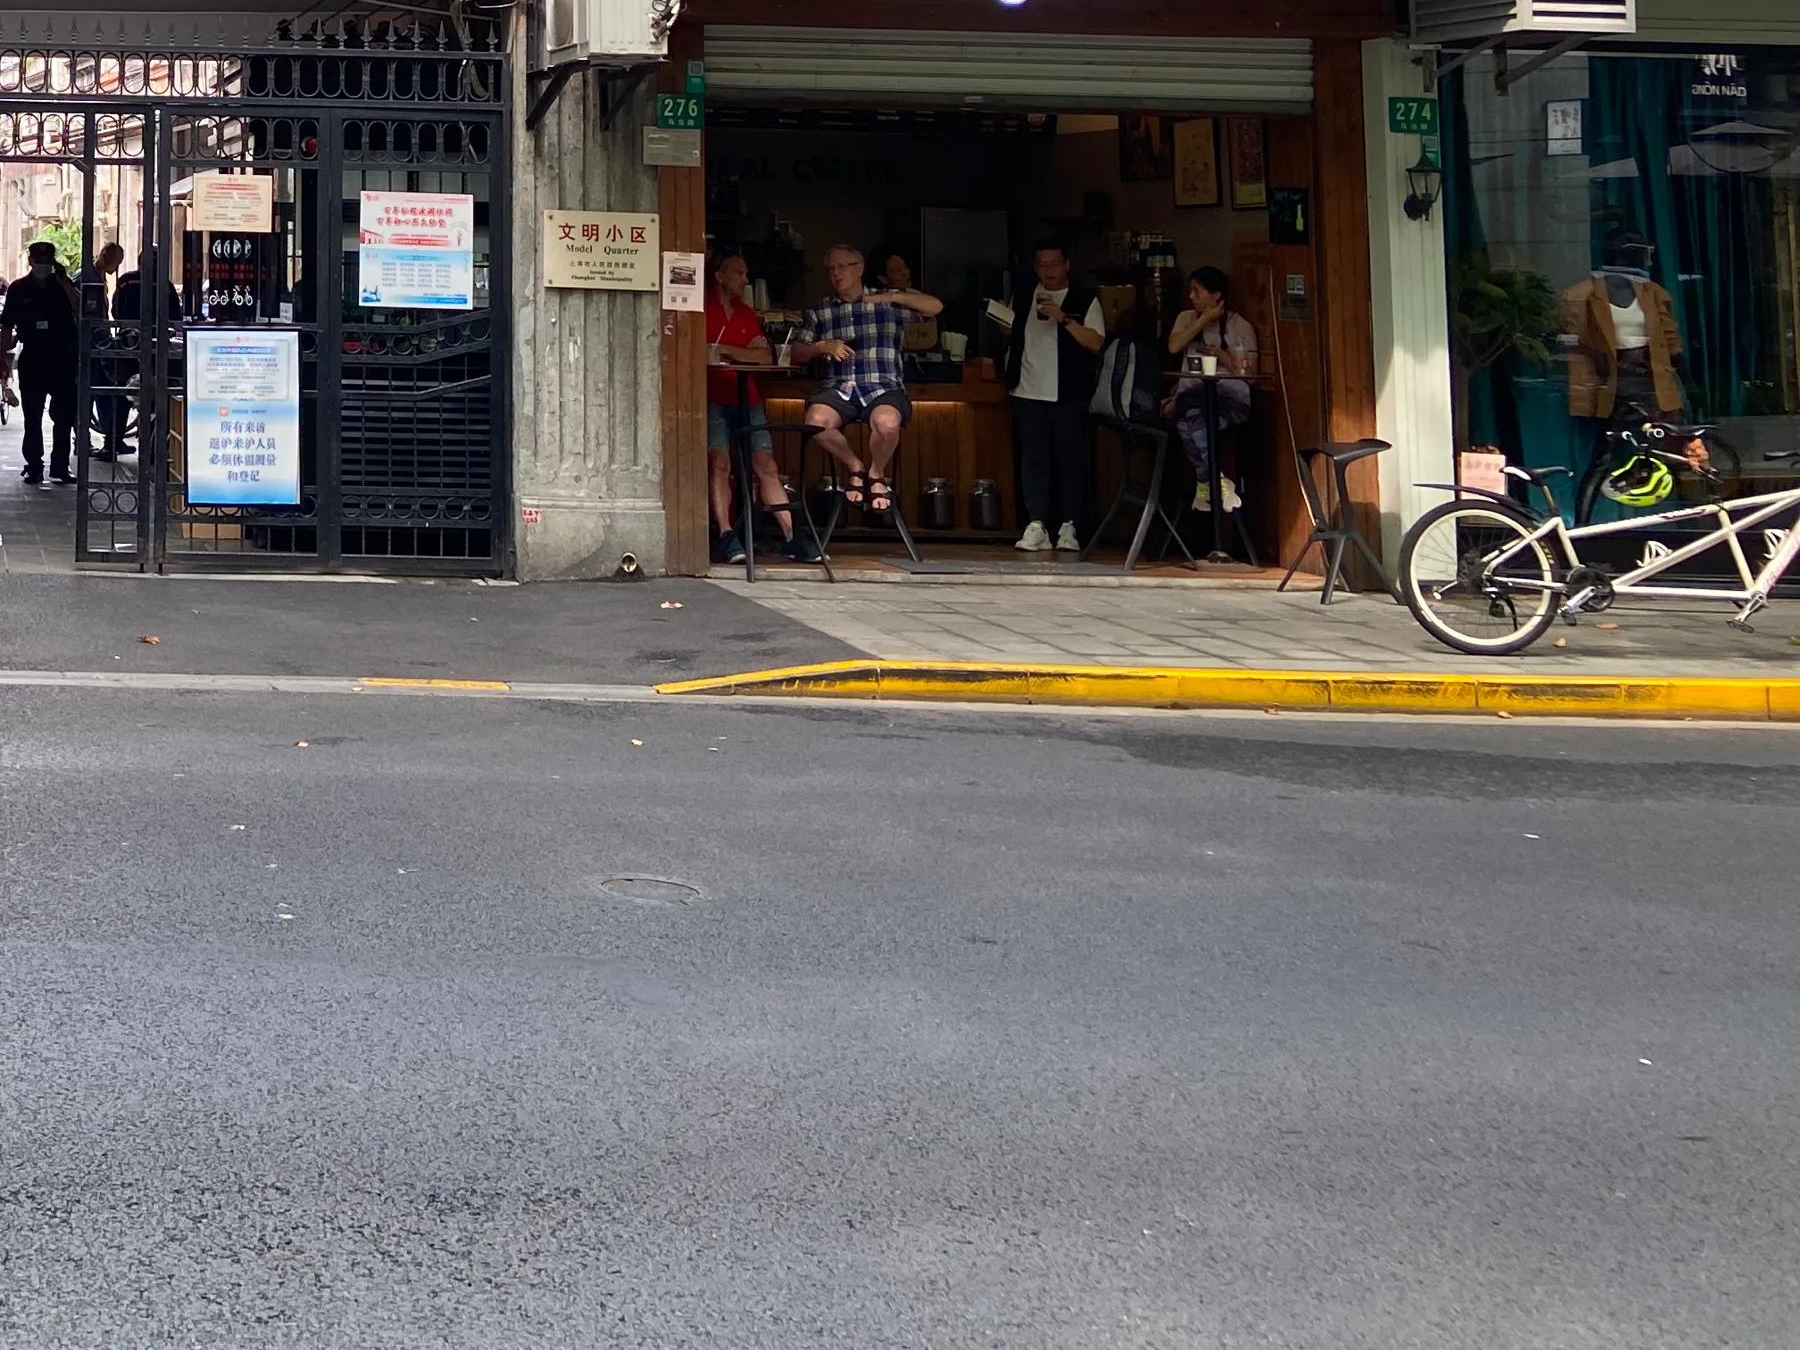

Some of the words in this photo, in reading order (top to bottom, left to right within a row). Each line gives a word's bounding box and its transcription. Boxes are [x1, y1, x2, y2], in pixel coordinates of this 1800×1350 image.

[663, 98, 698, 117] 276
[1395, 102, 1432, 121] 274
[558, 223, 647, 244] 文明小区
[566, 244, 593, 254] Model
[603, 245, 640, 256] Quarter
[220, 420, 265, 433] 所有来访
[209, 437, 276, 450] 返沪来沪人员
[209, 453, 277, 467] 必须体温测量
[227, 470, 261, 483] 和登记
